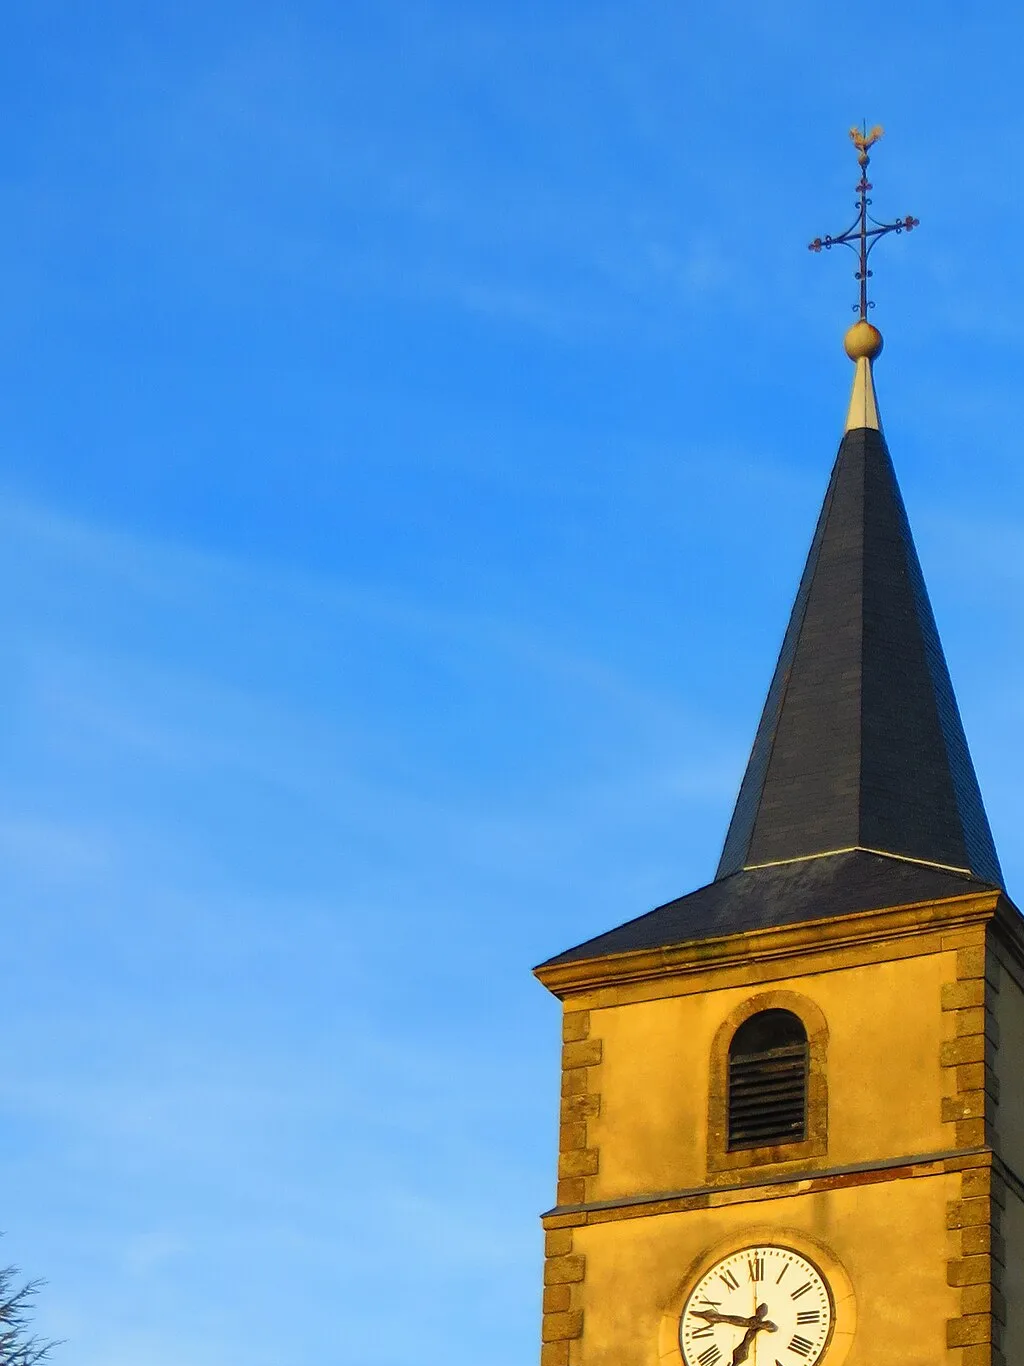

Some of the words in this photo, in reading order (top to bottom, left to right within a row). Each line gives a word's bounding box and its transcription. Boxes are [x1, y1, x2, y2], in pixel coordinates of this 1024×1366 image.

[748, 1258, 765, 1282] XII
[719, 1269, 740, 1294] XI
[790, 1281, 813, 1301] II
[699, 1294, 722, 1311] X
[796, 1310, 821, 1325] III
